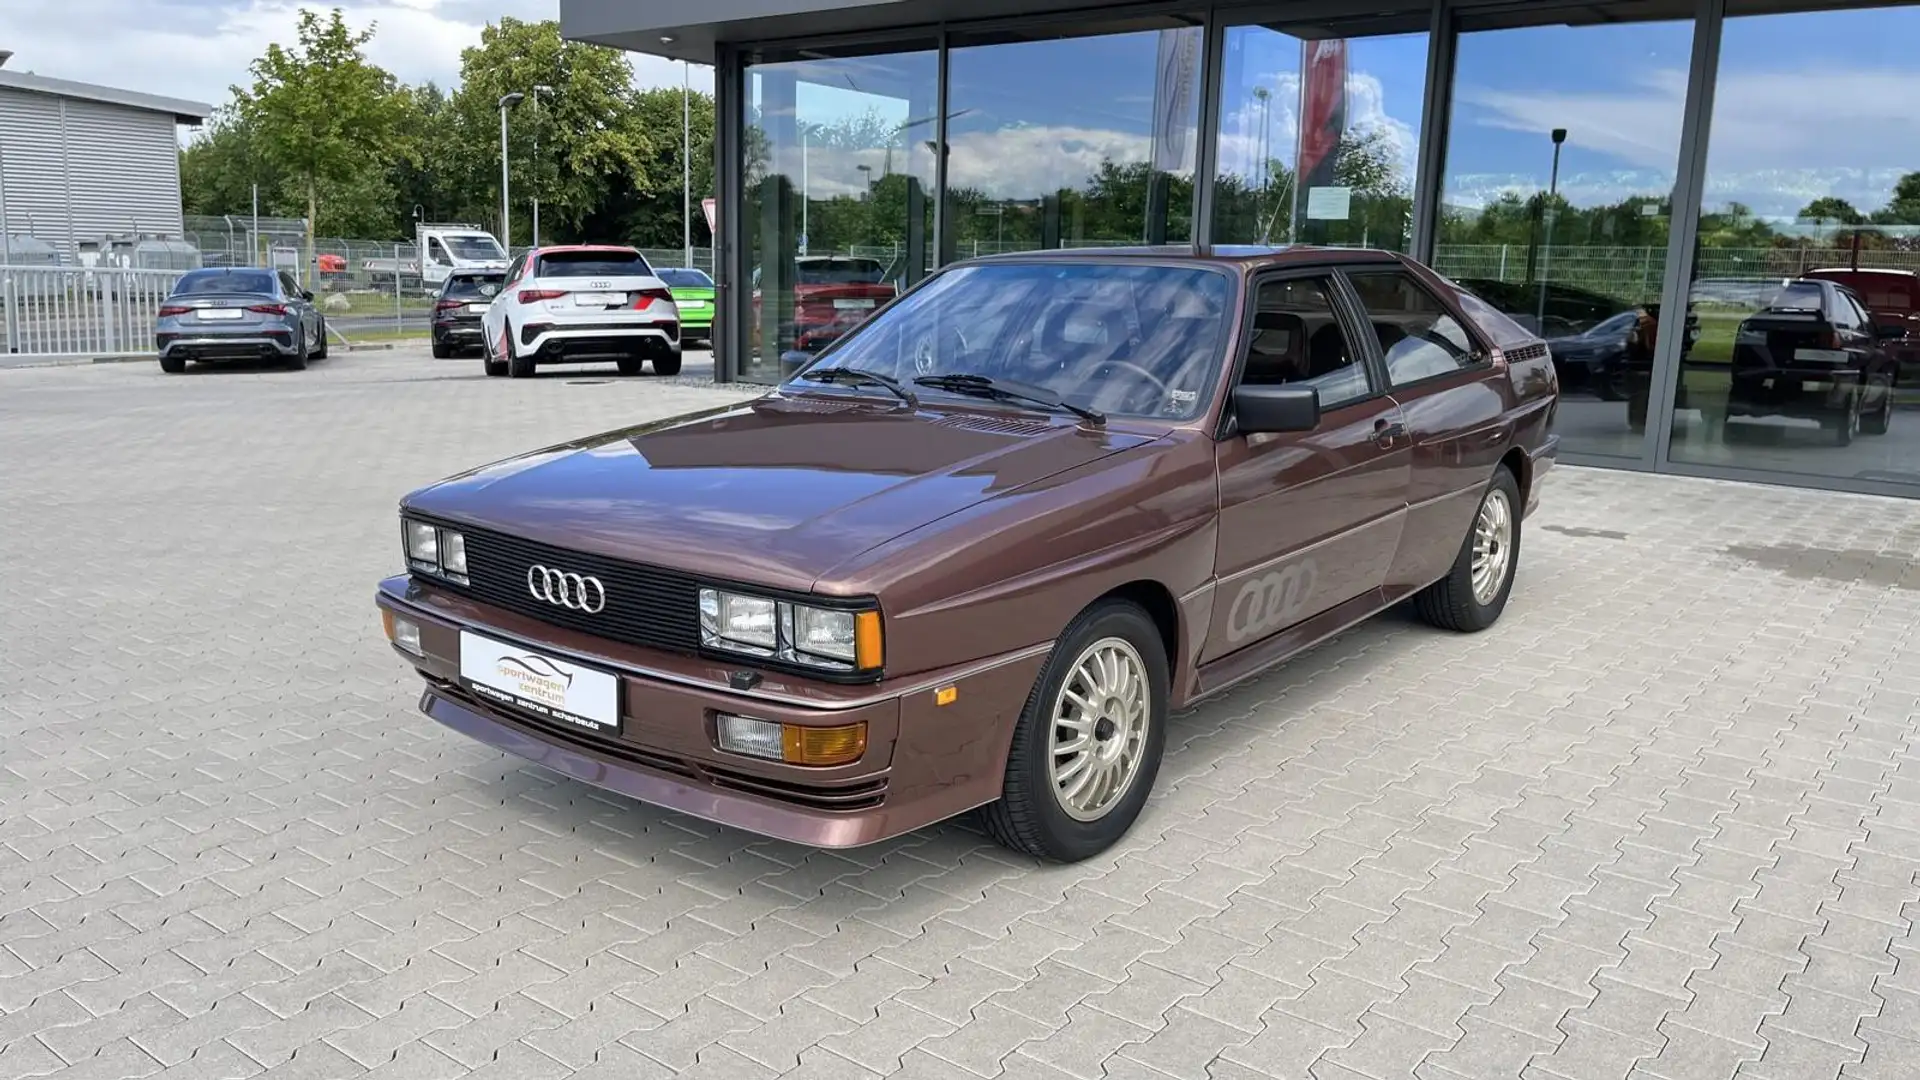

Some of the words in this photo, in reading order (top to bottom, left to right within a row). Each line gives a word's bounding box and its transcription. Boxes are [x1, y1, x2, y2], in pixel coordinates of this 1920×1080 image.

[471, 683, 514, 702] sportwagen
[516, 698, 549, 714] zentrum
[519, 682, 565, 702] zentrum
